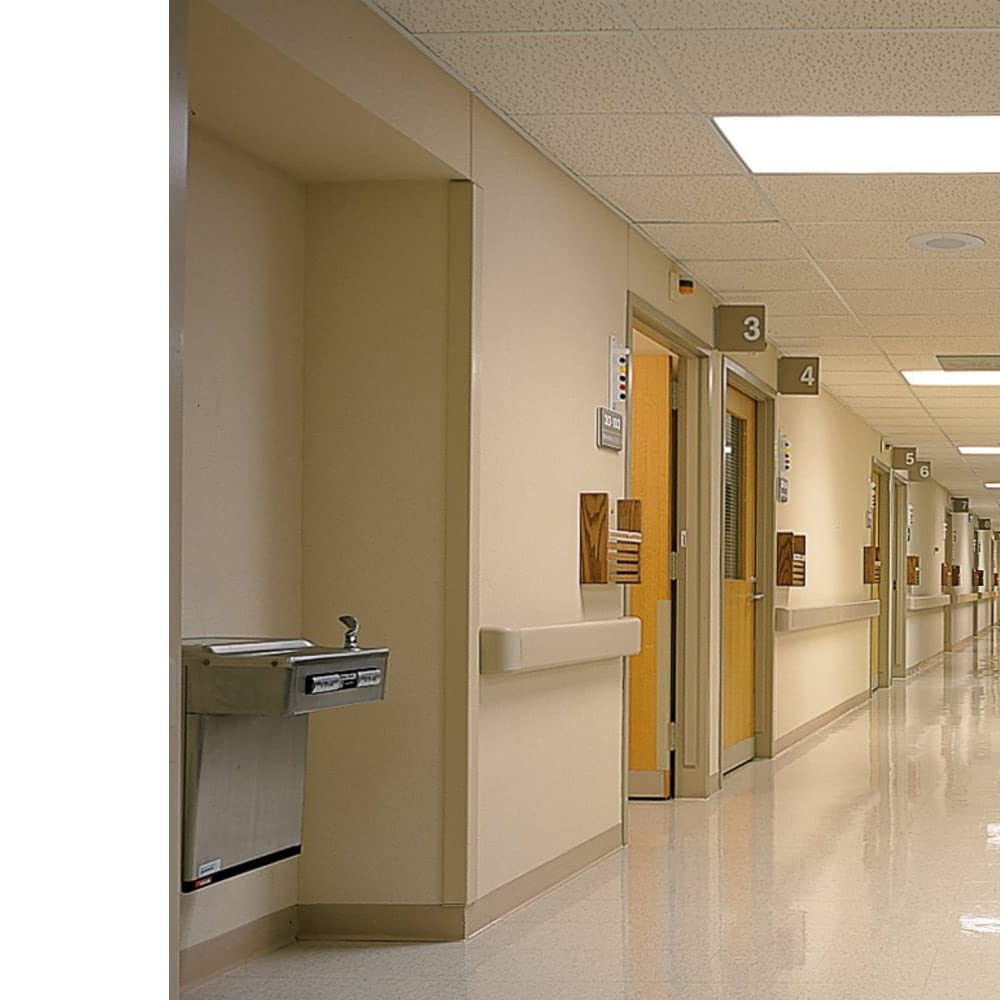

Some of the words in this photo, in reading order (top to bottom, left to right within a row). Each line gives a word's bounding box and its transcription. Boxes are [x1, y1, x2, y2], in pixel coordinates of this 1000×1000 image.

[744, 316, 760, 341] 3
[800, 366, 815, 386] 4
[906, 452, 914, 465] 5
[920, 465, 929, 478] 6
[962, 501, 968, 510] 7
